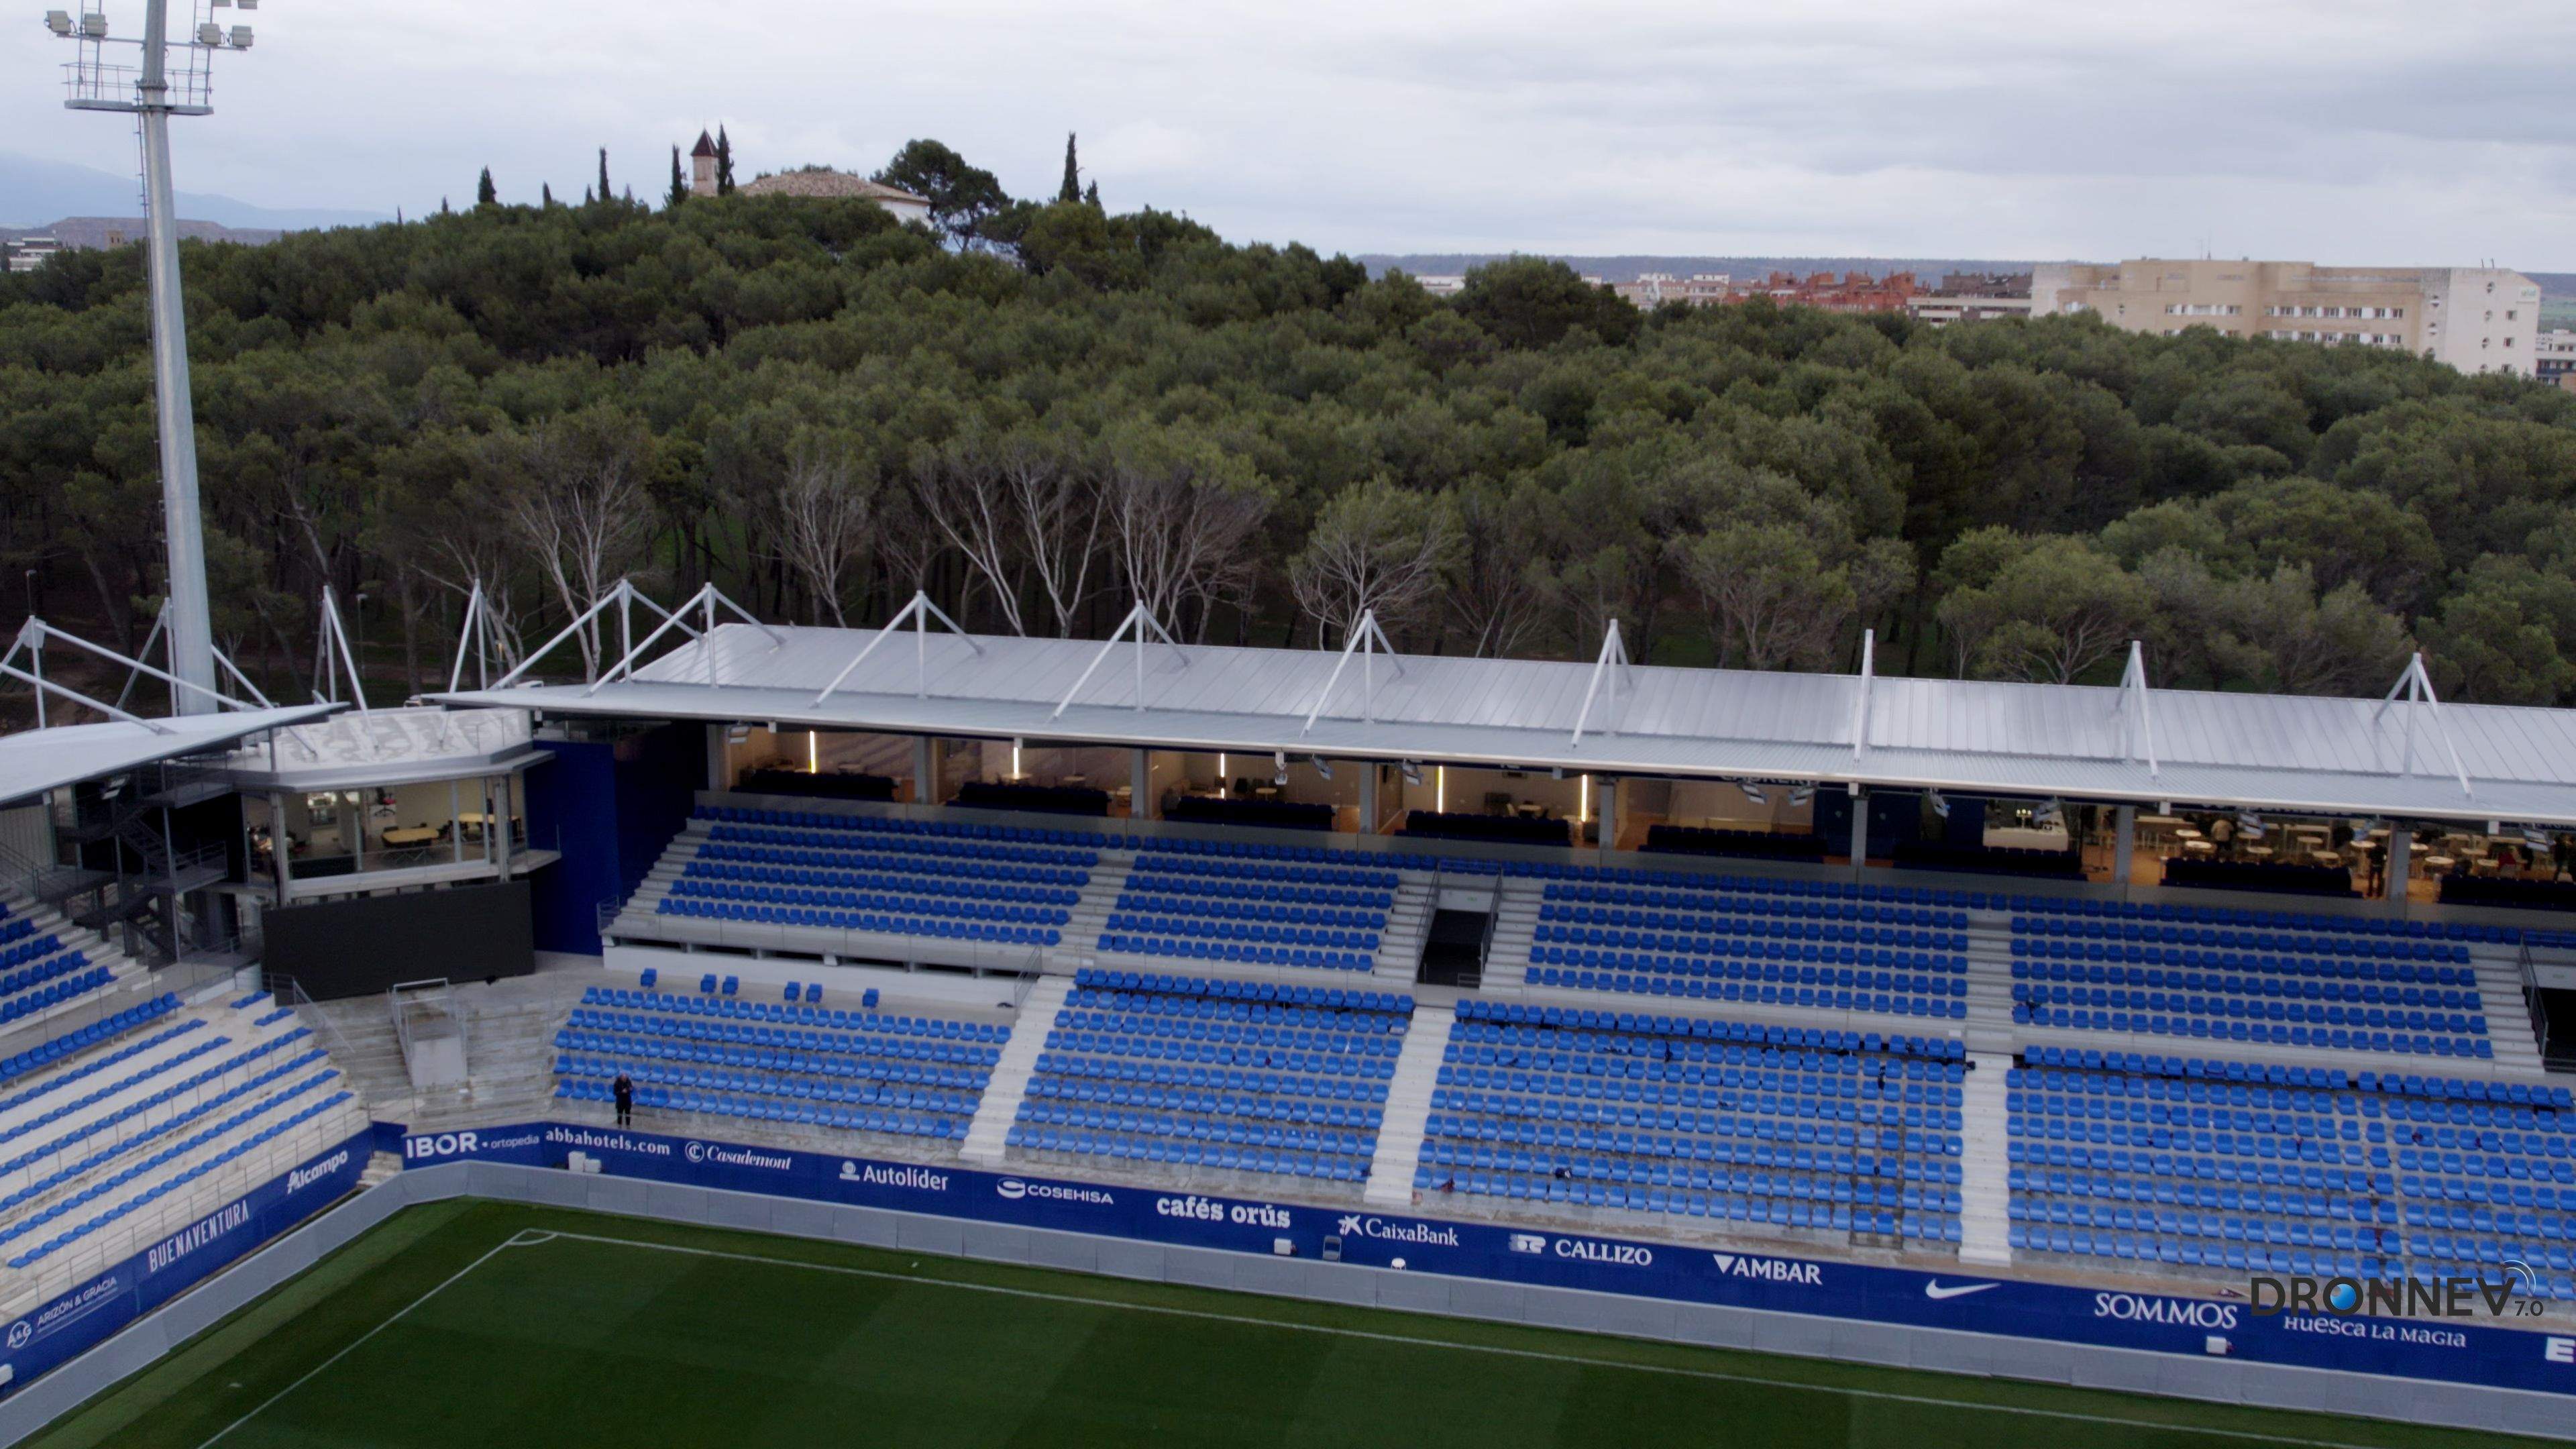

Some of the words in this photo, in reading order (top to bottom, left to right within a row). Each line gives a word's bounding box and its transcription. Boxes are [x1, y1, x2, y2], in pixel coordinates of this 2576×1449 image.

[407, 1132, 478, 1159] IBOR
[490, 1134, 539, 1150] ortopedia
[545, 1127, 670, 1155] abbahotels.com
[706, 1145, 792, 1170] Casademont
[286, 1150, 348, 1195] Alcampo
[863, 1165, 949, 1191] Autolíder
[1027, 1184, 1114, 1205] COSEHISA
[1157, 1196, 1224, 1222] cafés
[1230, 1204, 1291, 1229] orús
[148, 1199, 250, 1273] BUENAVENTURA
[1366, 1218, 1460, 1247] CaixaBank
[1555, 1239, 1653, 1267] CALLIZO
[1733, 1257, 1823, 1285] AMBAR
[83, 1276, 118, 1301] GRACIA
[2094, 1293, 2238, 1330] SOMMOS
